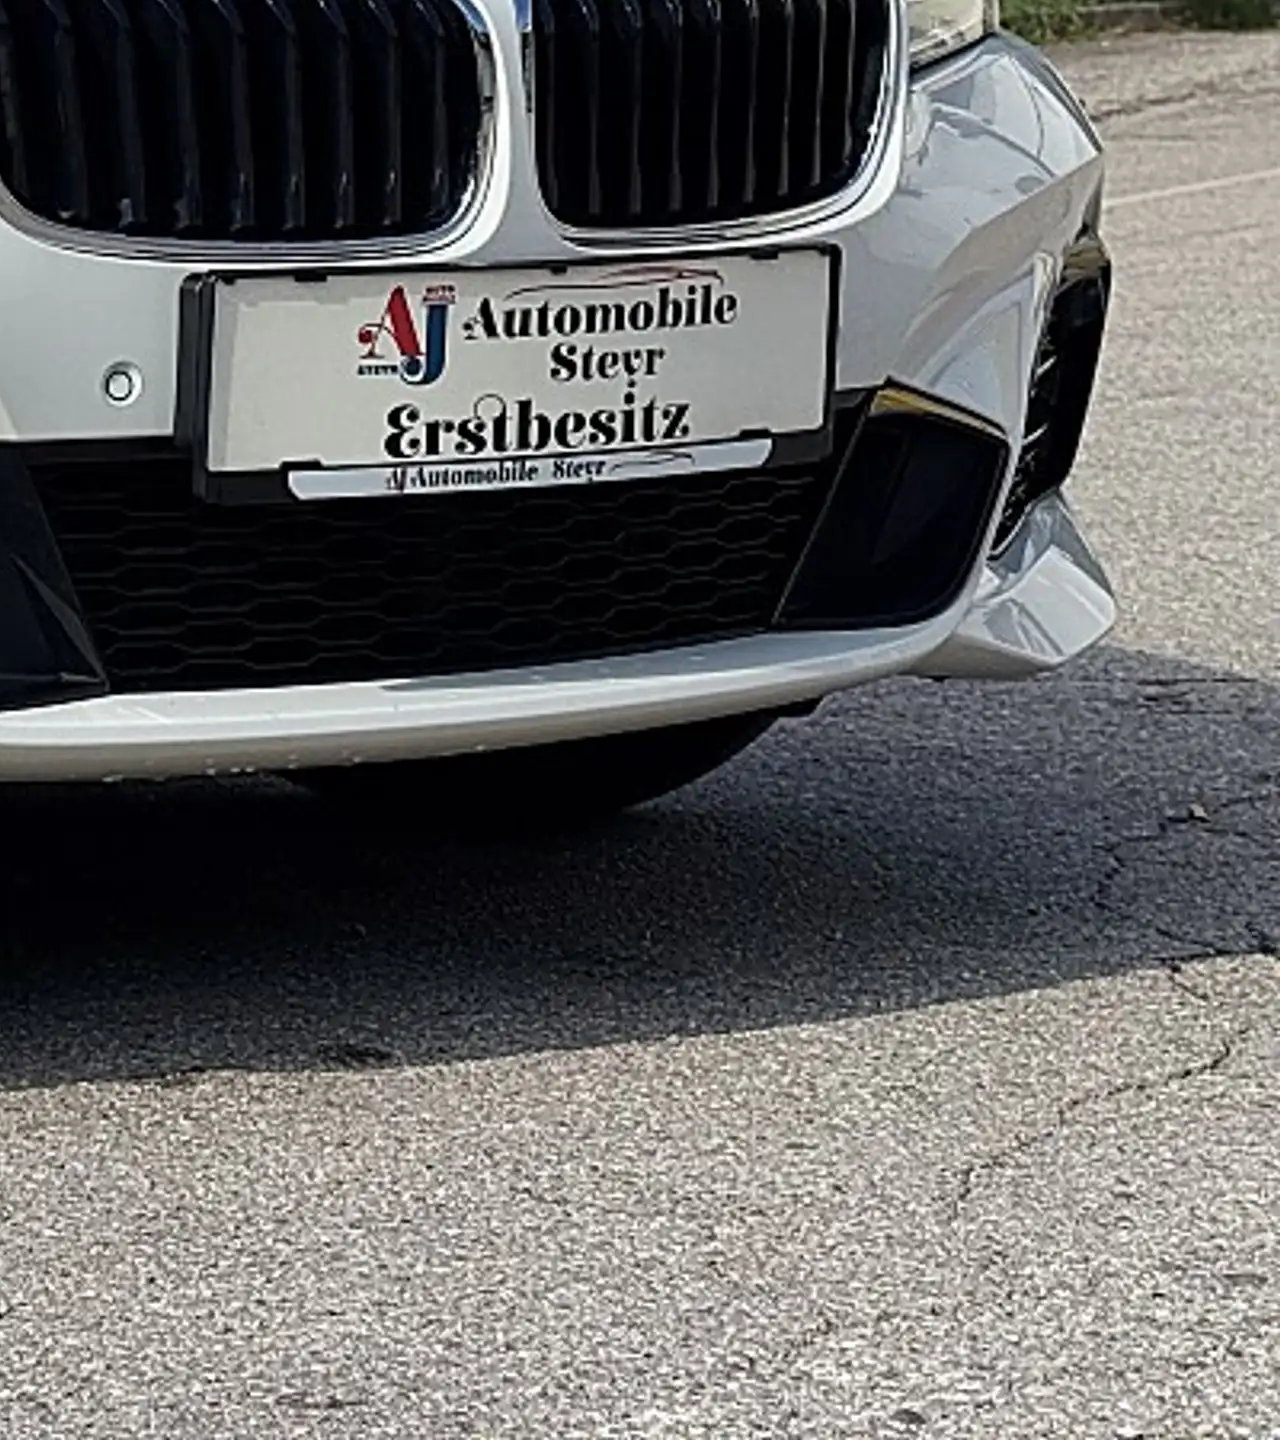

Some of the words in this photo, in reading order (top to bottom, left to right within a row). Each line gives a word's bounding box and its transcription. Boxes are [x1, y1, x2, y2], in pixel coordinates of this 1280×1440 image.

[462, 284, 738, 340] Automobile
[550, 341, 666, 388] Steyr
[384, 392, 691, 459] Erstbesitz
[410, 460, 539, 489] Automobile
[551, 458, 606, 483] Steyr
